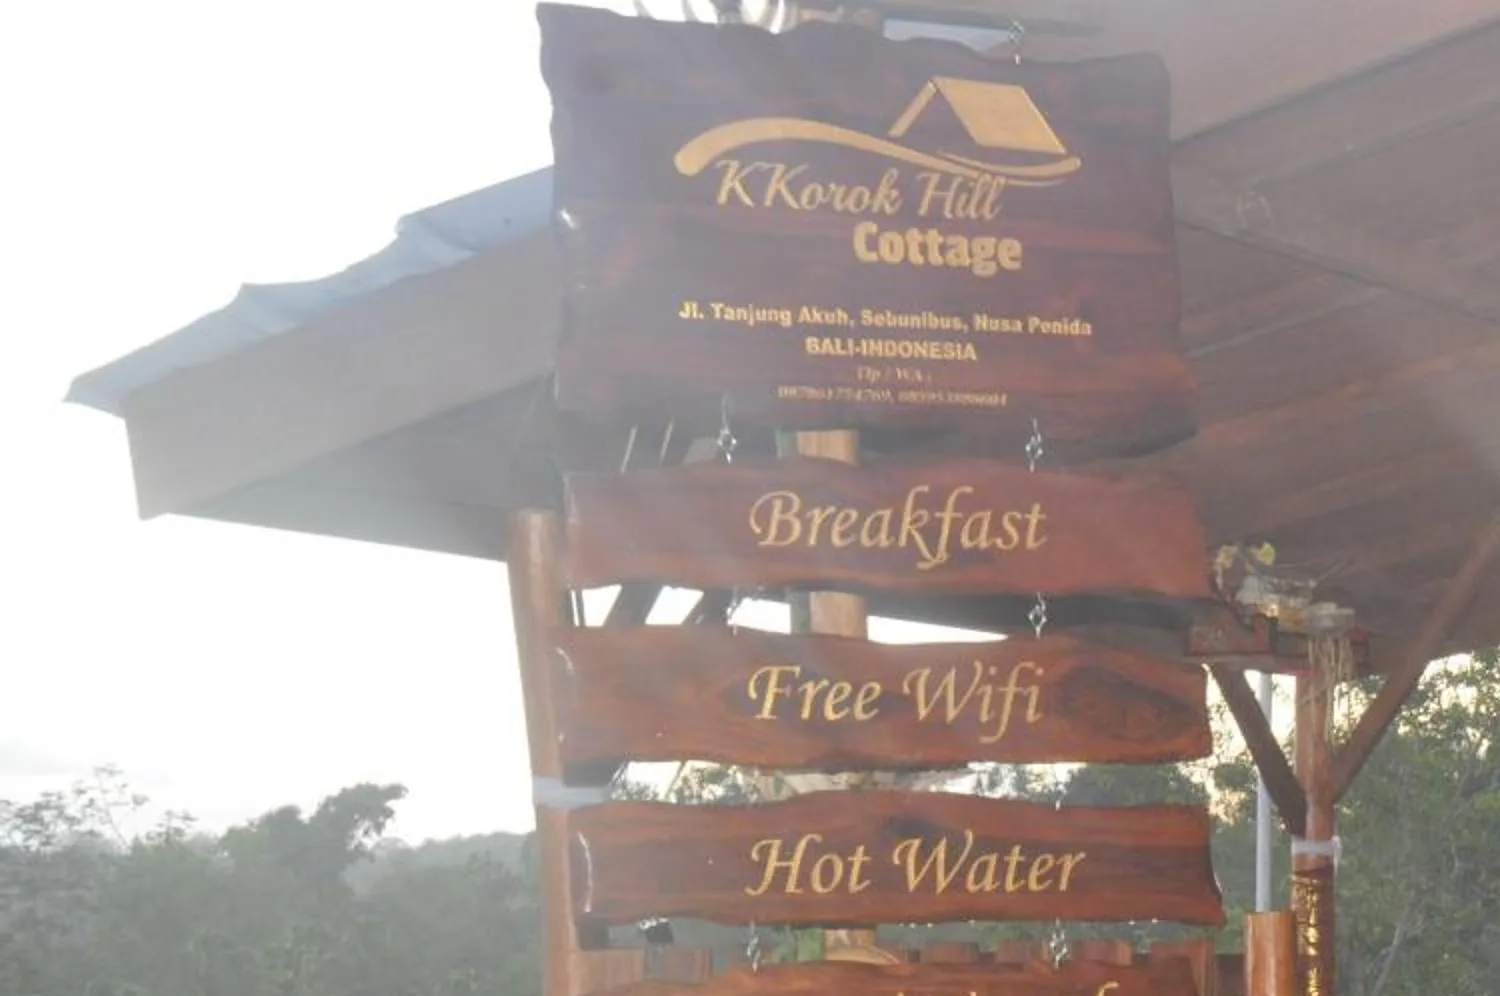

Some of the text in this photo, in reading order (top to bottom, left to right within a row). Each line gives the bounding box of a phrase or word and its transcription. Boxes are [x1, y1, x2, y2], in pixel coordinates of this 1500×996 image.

[915, 173, 1003, 222] Hill
[853, 221, 1024, 278] Cottage
[710, 303, 793, 327] Tanjung
[974, 313, 1023, 334] Nusa
[1028, 315, 1093, 337] Penida
[749, 486, 1048, 570] Breakfast
[747, 660, 1045, 744] Free Wifi
[745, 830, 1087, 896] Hot Water
